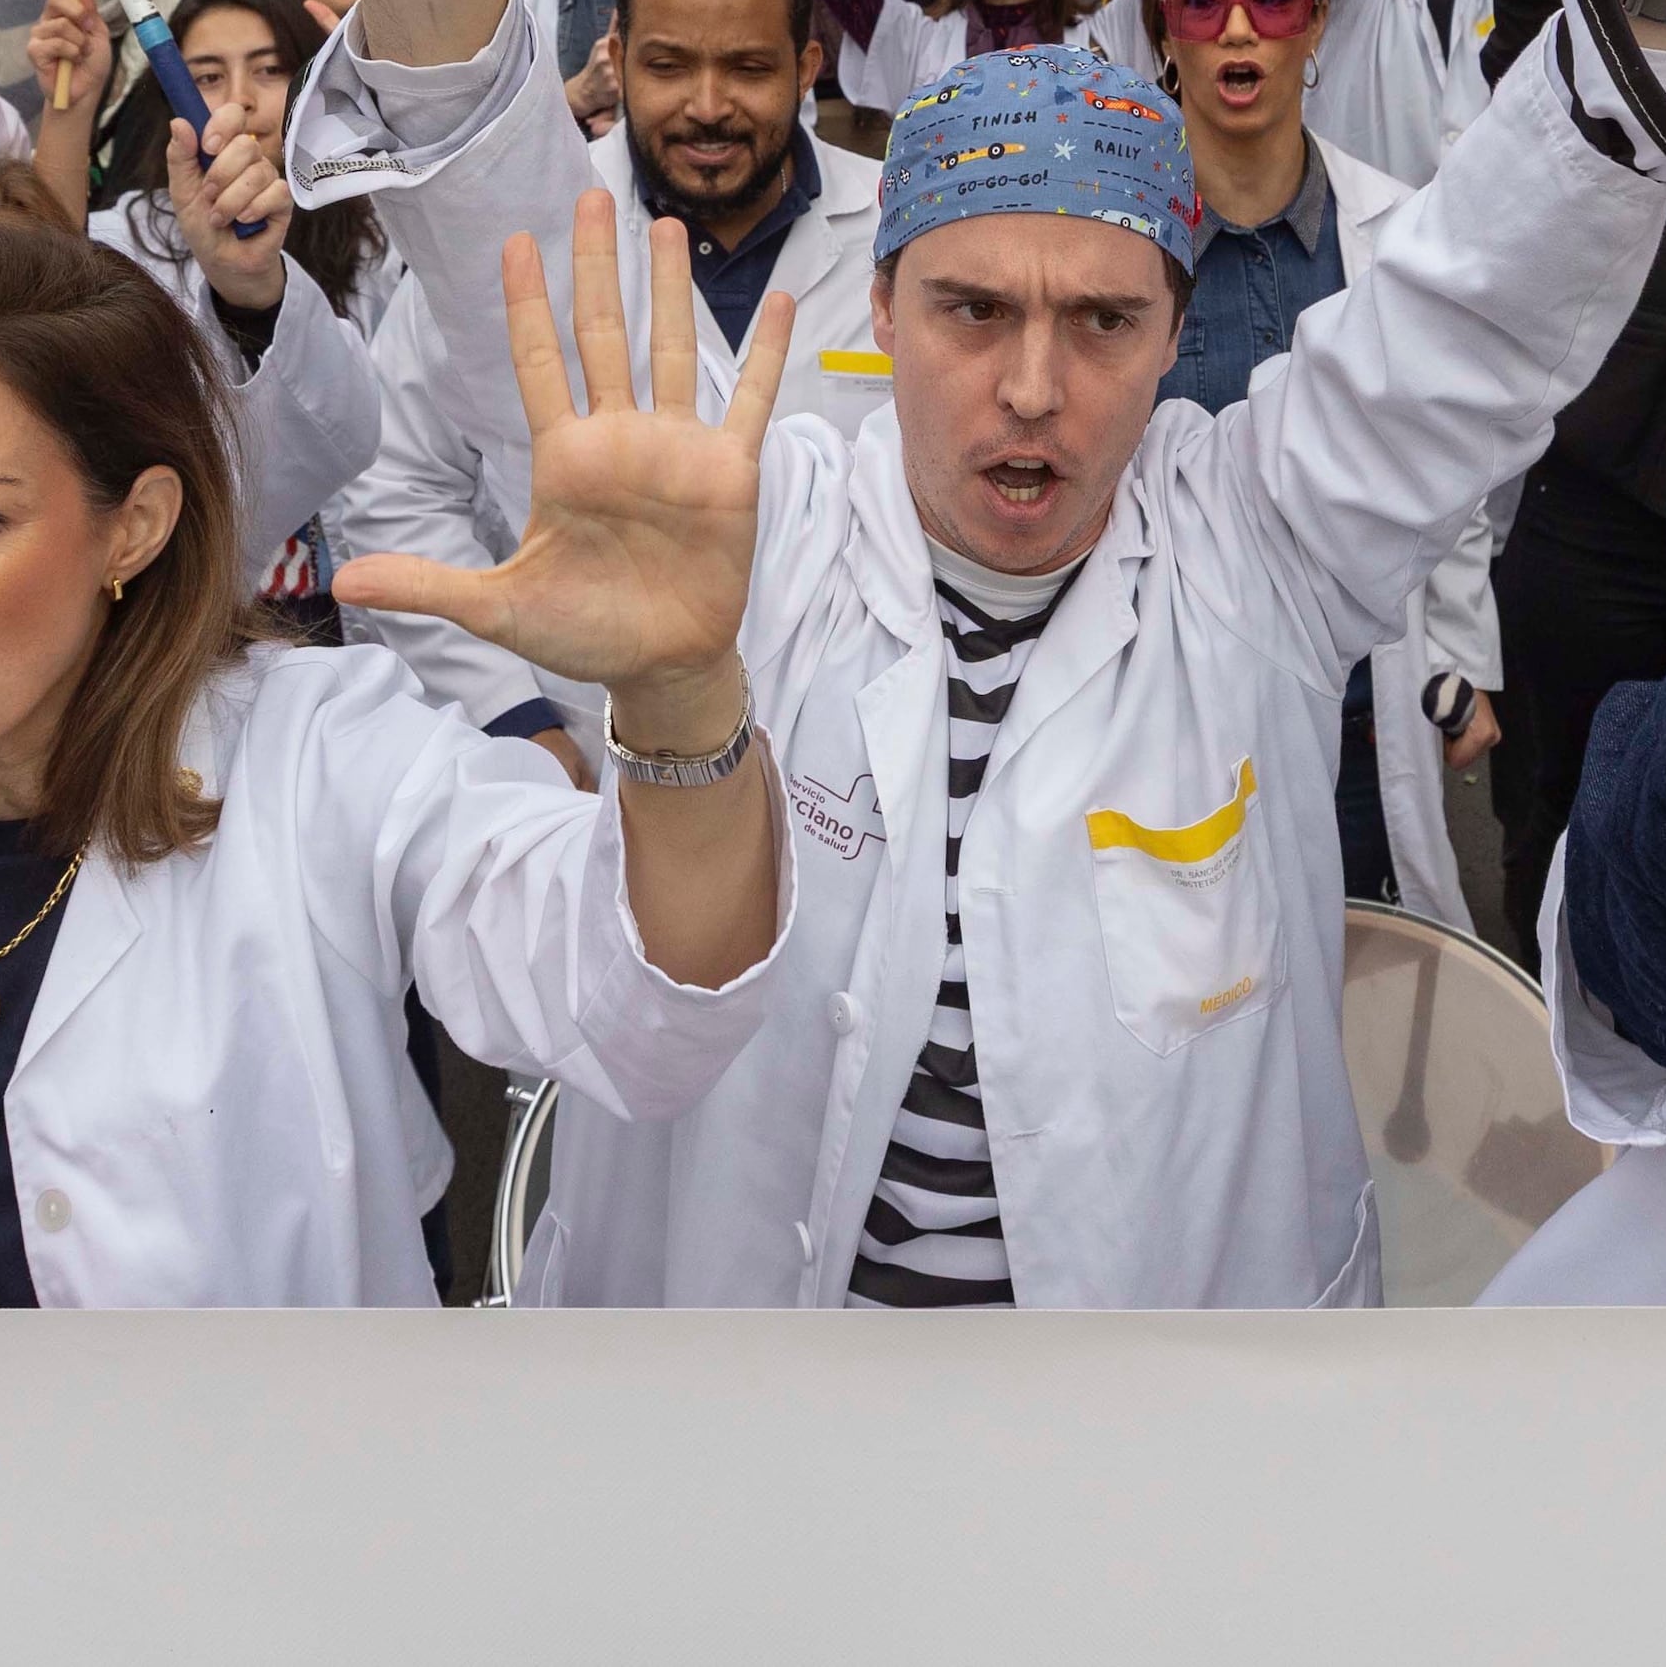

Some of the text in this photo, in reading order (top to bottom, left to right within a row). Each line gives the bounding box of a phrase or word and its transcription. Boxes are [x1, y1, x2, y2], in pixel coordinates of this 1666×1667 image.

[971, 111, 1038, 130] FINISH
[1094, 139, 1142, 161] RALLY
[957, 170, 1049, 196] GO-GO-GO!
[789, 791, 853, 840] rciano
[804, 824, 848, 853] de salud
[1200, 976, 1252, 1015] MÉDICO
